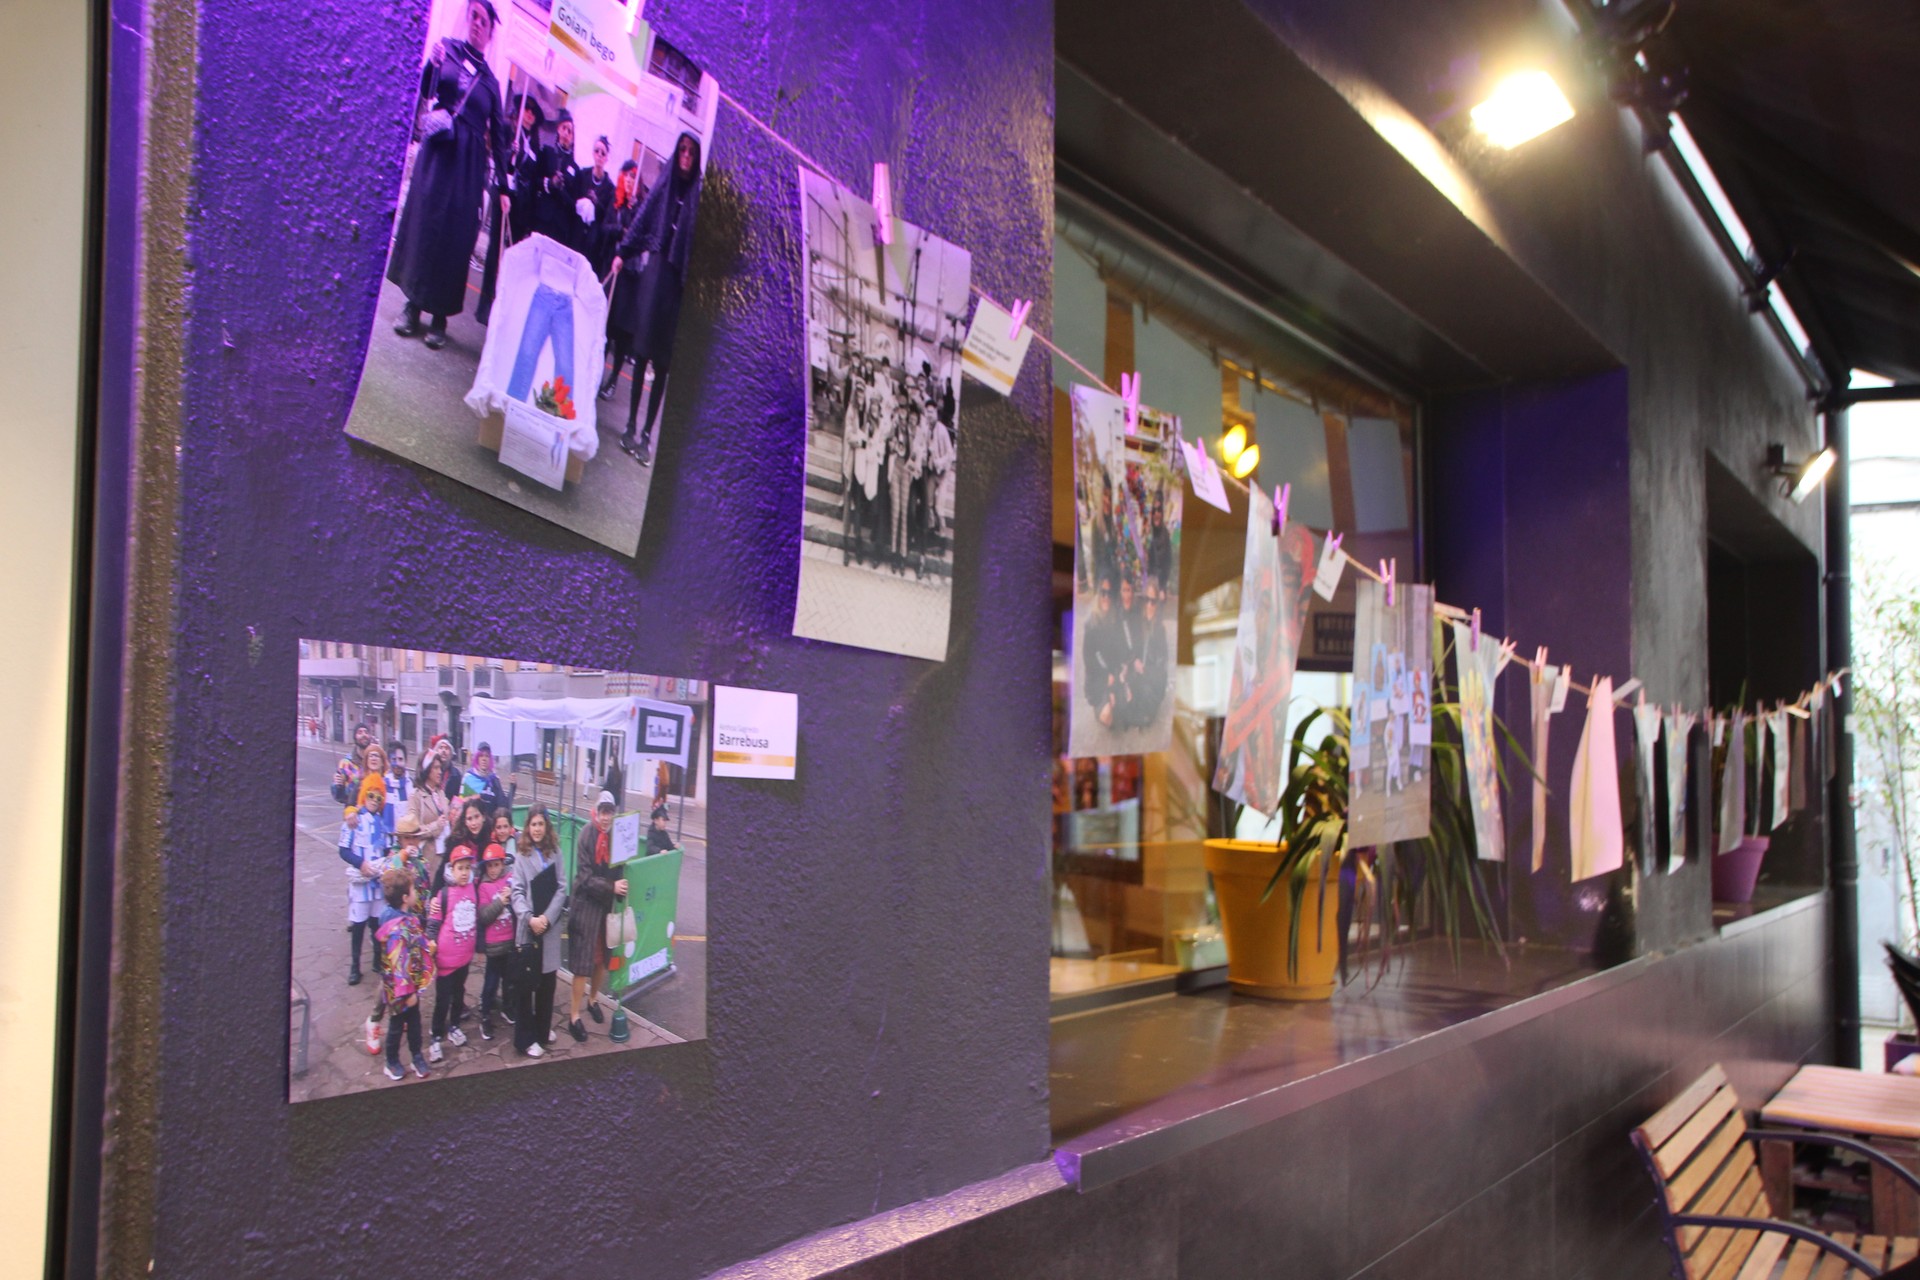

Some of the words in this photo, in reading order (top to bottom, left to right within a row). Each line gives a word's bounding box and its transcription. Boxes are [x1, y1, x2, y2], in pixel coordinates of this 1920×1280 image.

[558, 7, 588, 39] Goian
[590, 33, 616, 62] bego
[719, 733, 769, 749] Barrebusa
